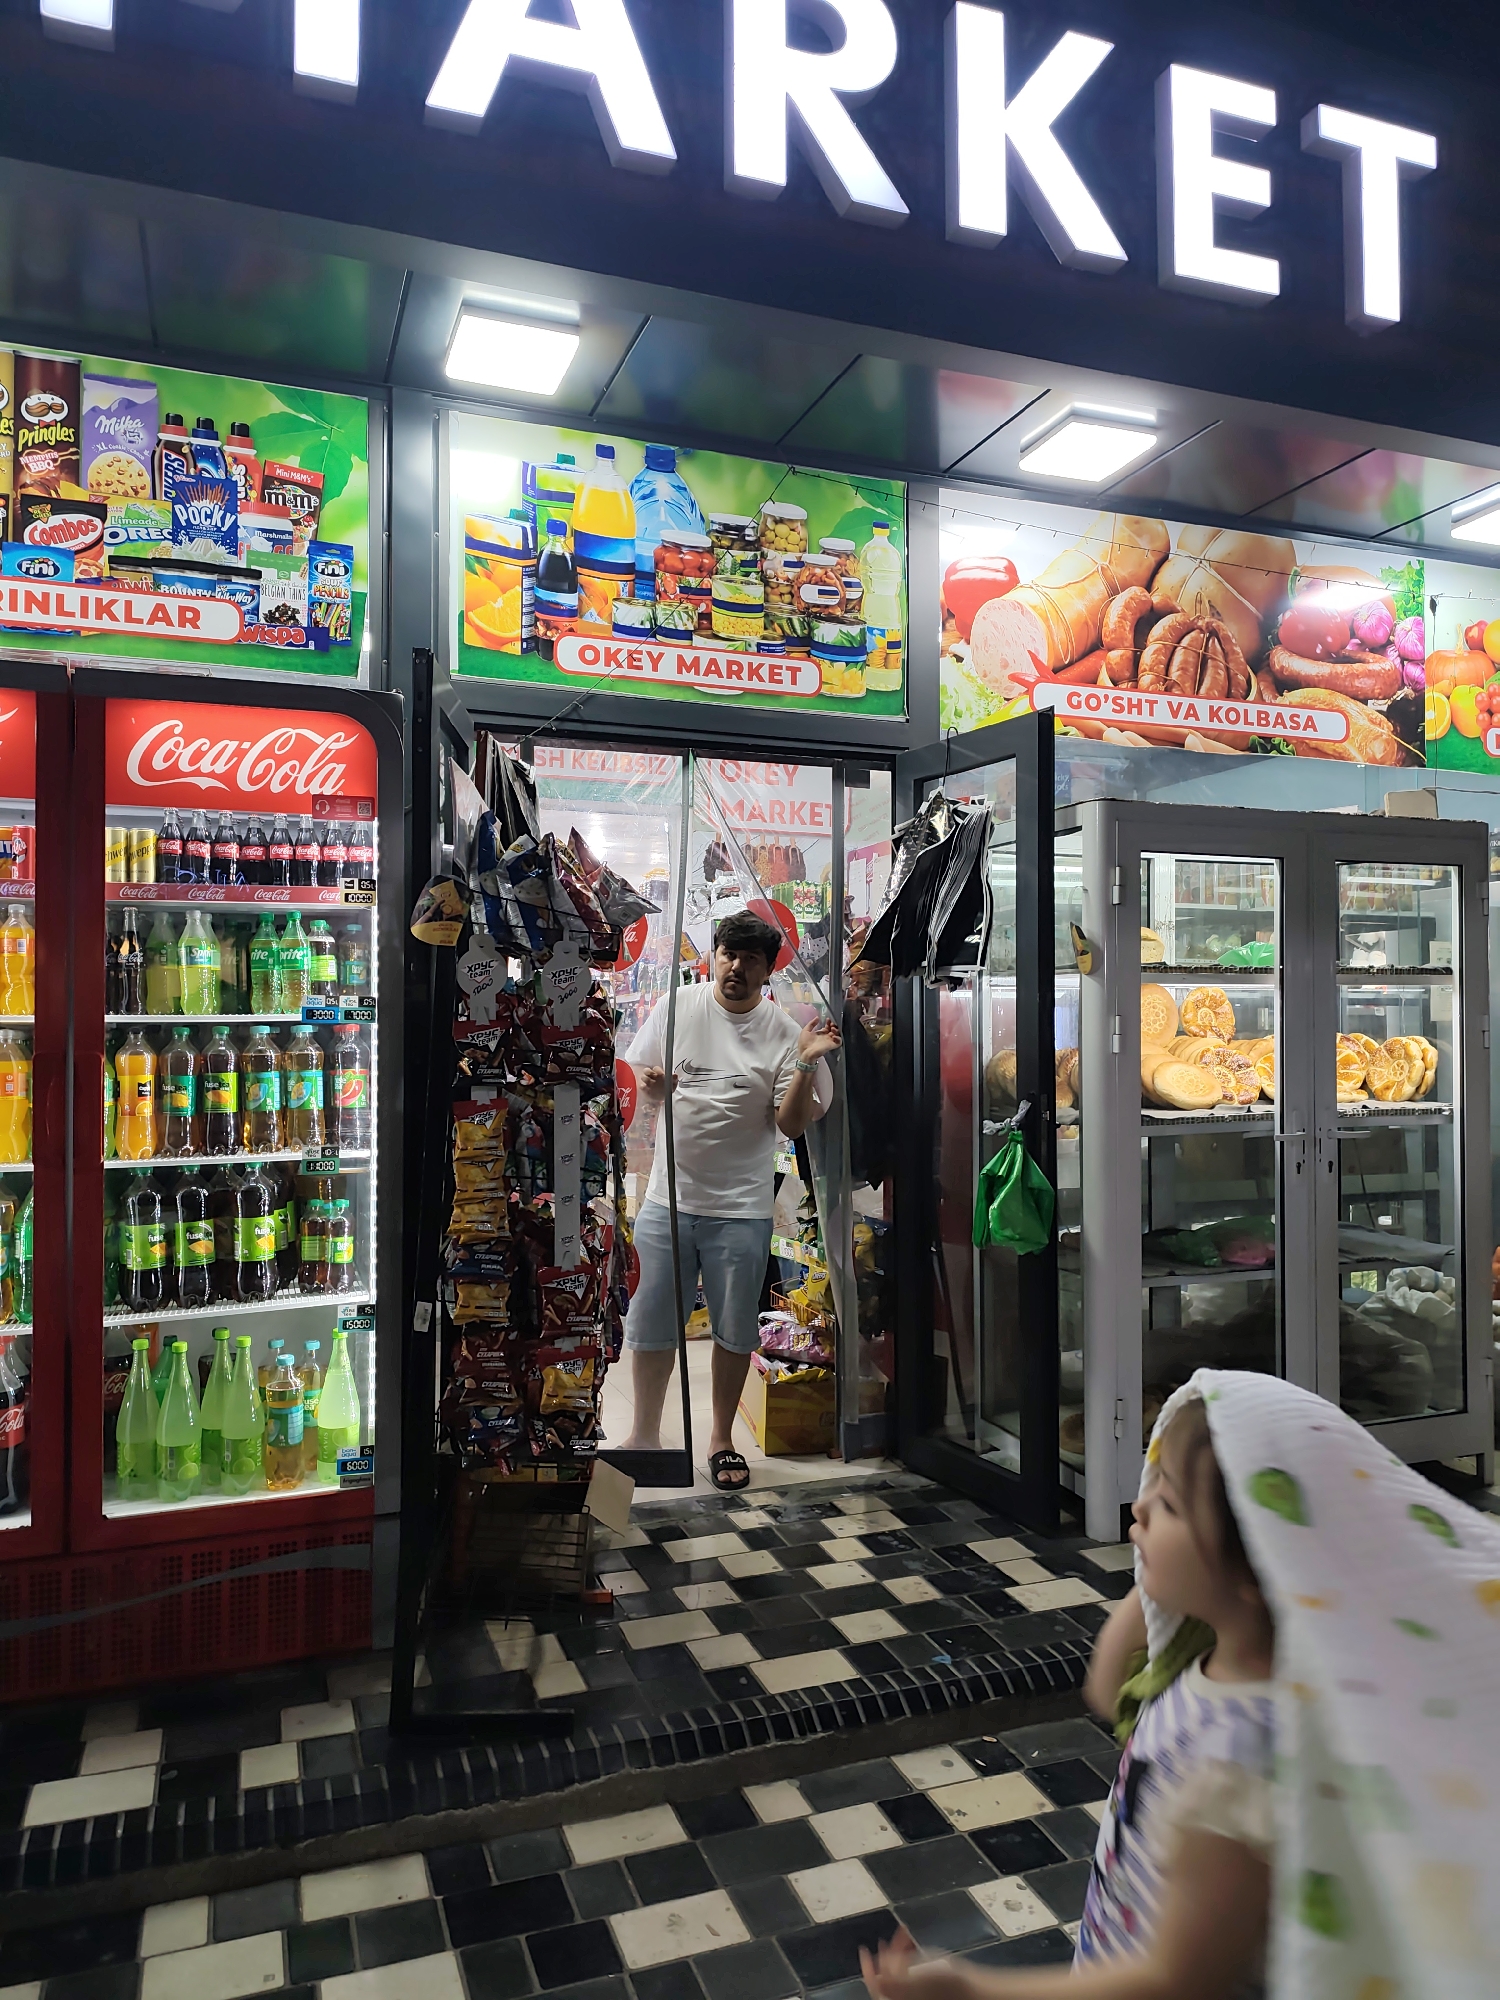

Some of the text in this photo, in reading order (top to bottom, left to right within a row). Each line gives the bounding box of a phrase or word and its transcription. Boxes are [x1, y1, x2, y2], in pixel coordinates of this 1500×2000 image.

[95, 415, 145, 435] Milka
[18, 422, 76, 452] Pringles
[19, 451, 59, 465] MEMPHIS
[28, 460, 55, 473] BBQ
[275, 467, 290, 477] Mini
[110, 515, 158, 526] Limeade
[28, 517, 99, 546] Combos
[21, 558, 55, 576] Fini
[318, 562, 345, 577] Fini
[261, 584, 307, 600] BELGIAN THINS
[313, 585, 349, 600] PENCILS
[578, 644, 802, 686] OKEY MARKET
[1066, 690, 1319, 732] GO'SHT VA KOLBASA
[126, 719, 360, 796] Coca-Cola
[571, 750, 668, 776] KELIBSIZ
[718, 760, 800, 788] OKEY
[1, 881, 35, 895] Coca-Col
[119, 886, 158, 899] Coca-Cola
[188, 887, 226, 900] Coca-Cola
[254, 889, 292, 901] Coca-Cola
[319, 890, 340, 901] Coca-
[251, 950, 268, 960] rite
[279, 948, 303, 961] prite
[466, 959, 494, 973] ХРУС
[550, 966, 579, 979] ХРУС
[469, 968, 491, 980] team
[553, 975, 575, 986] team
[557, 987, 578, 1005] 3000
[312, 1009, 334, 1019] 3000
[469, 1028, 500, 1042] ХРУС
[477, 1035, 499, 1047] team
[162, 1083, 175, 1091] fuse
[204, 1081, 219, 1089] fuse
[148, 1232, 163, 1242] fuse
[186, 1231, 203, 1240] fuse
[255, 1227, 270, 1236] fuse
[555, 1274, 586, 1289] ХРУС
[564, 1281, 586, 1293] team
[346, 1319, 370, 1330] 15000
[346, 1460, 369, 1471] 6000
[718, 1454, 744, 1466] FILA
